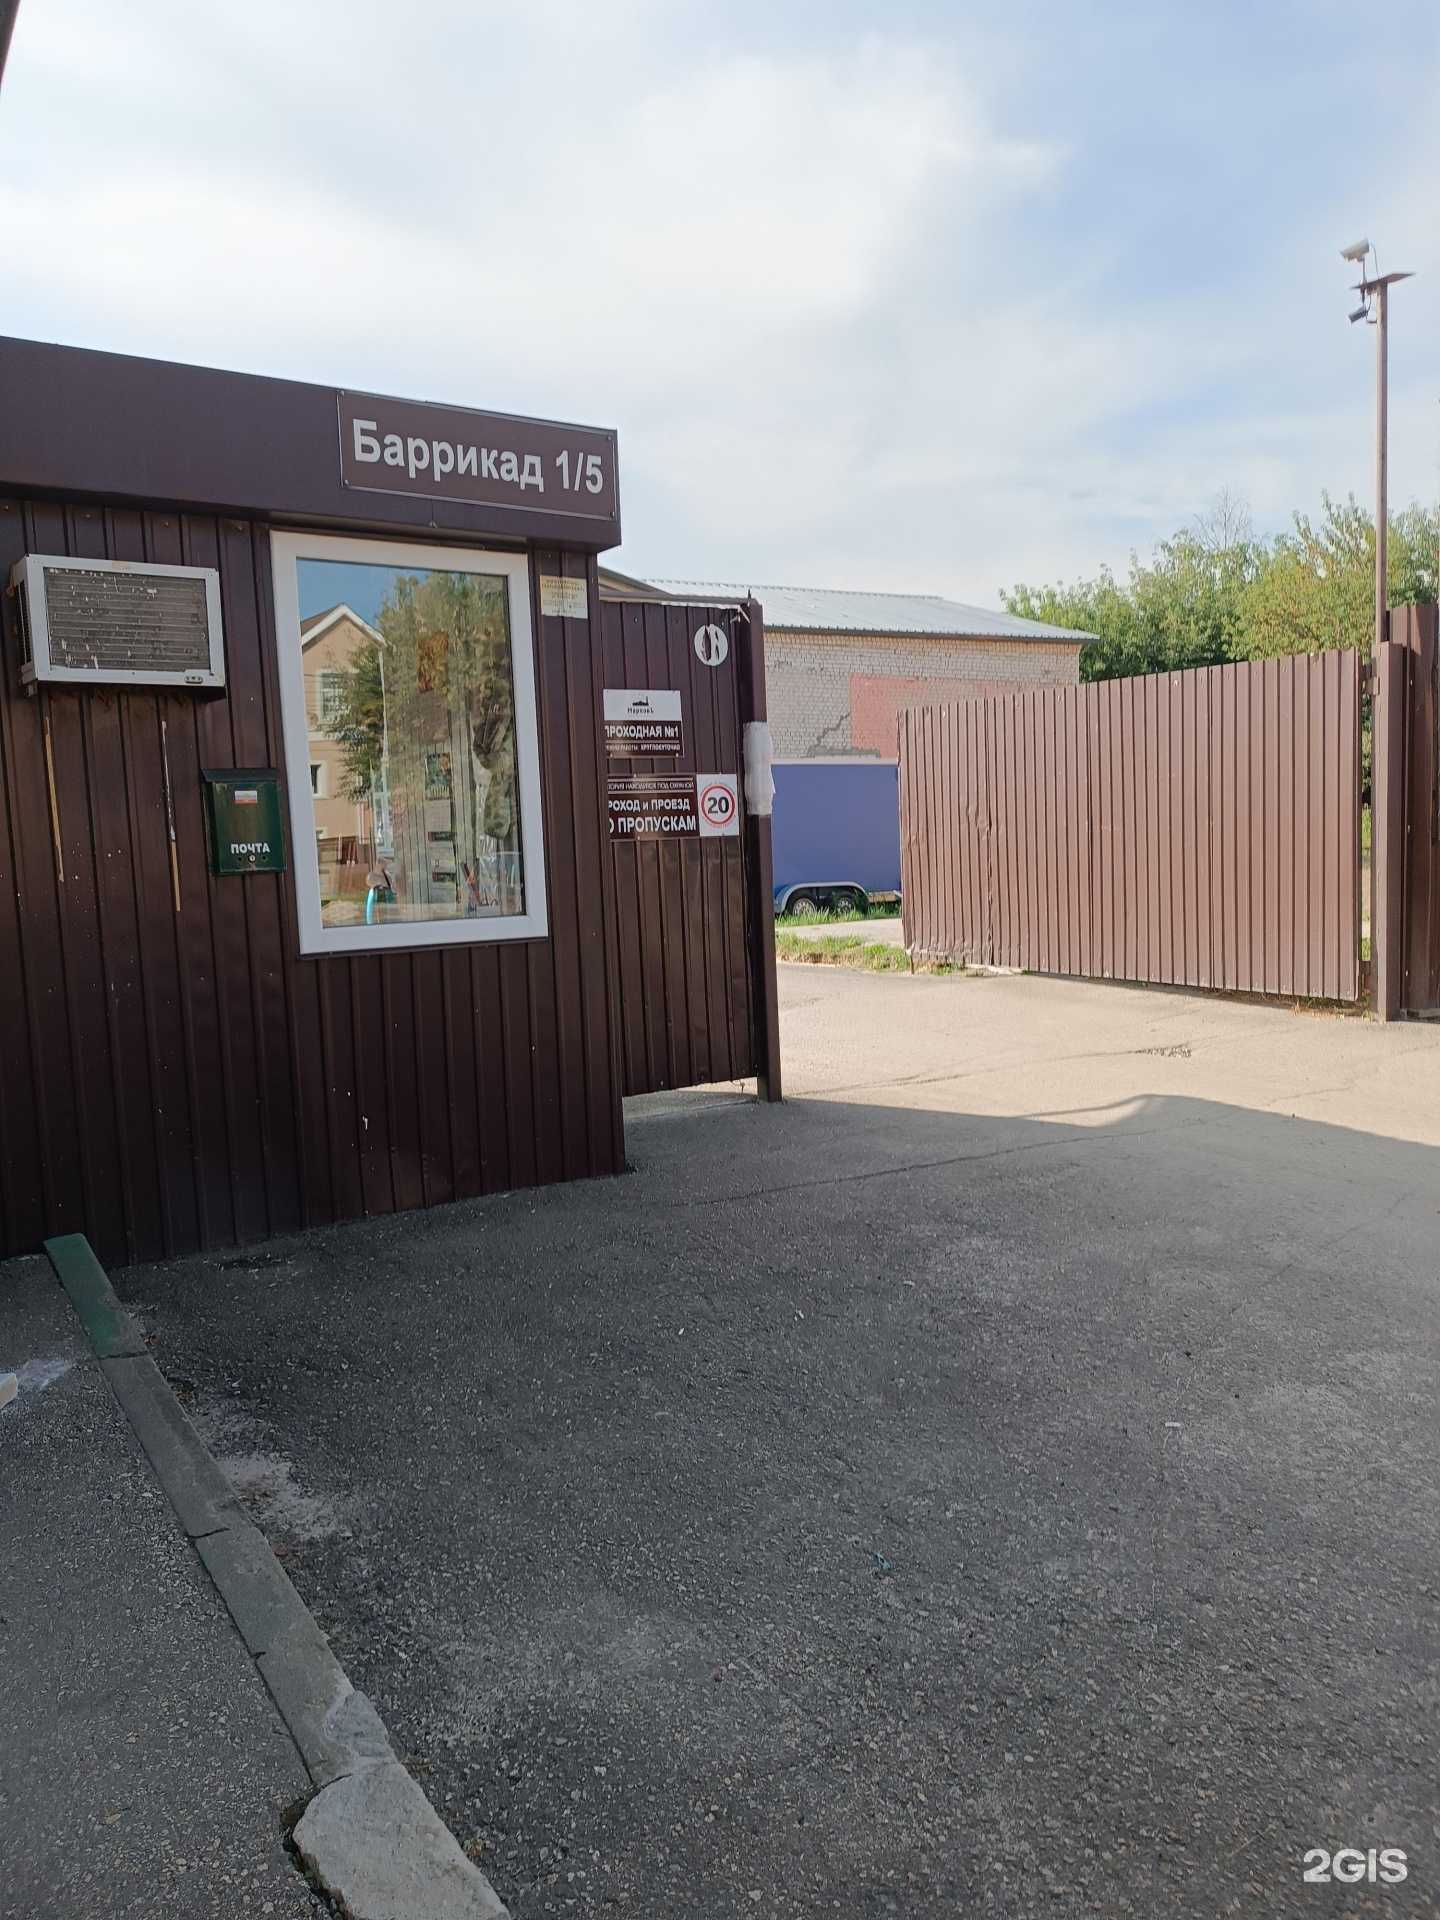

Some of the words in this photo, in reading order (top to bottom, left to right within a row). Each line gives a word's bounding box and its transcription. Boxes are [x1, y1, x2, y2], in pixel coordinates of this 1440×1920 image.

[353, 418, 545, 493] Баррикад
[555, 449, 604, 494] 1/5
[664, 724, 679, 738] №1
[608, 799, 641, 812] РОХОД
[651, 798, 691, 812] ПРОЕЗД
[707, 796, 730, 814] 20
[617, 815, 697, 833] ПРОПУСКАМ
[230, 842, 271, 854] ПОЧТА
